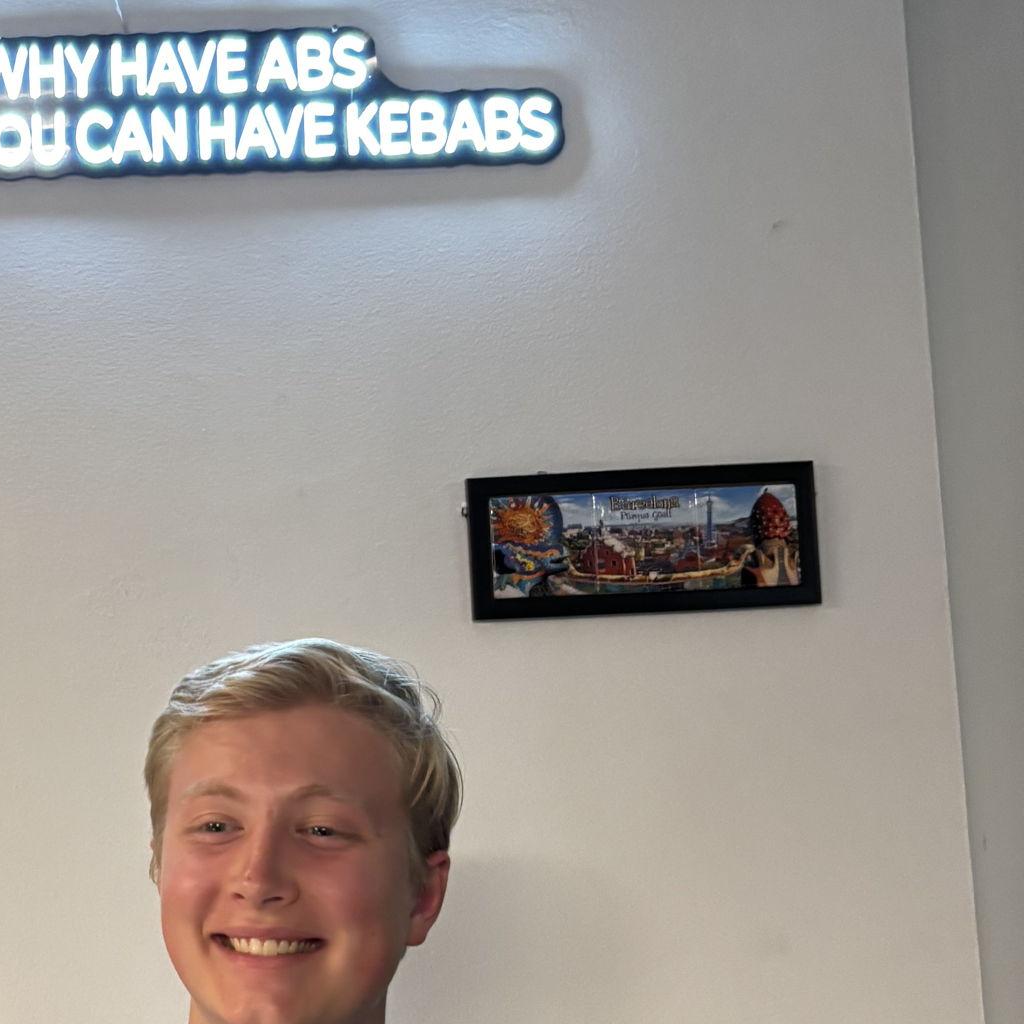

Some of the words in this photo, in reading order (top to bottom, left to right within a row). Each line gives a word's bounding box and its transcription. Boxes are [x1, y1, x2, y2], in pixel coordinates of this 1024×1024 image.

[109, 37, 248, 97] HAVE
[256, 34, 371, 92] ABS
[75, 106, 188, 165] CAN
[197, 103, 336, 160] HAVE
[345, 96, 557, 157] KEBABS
